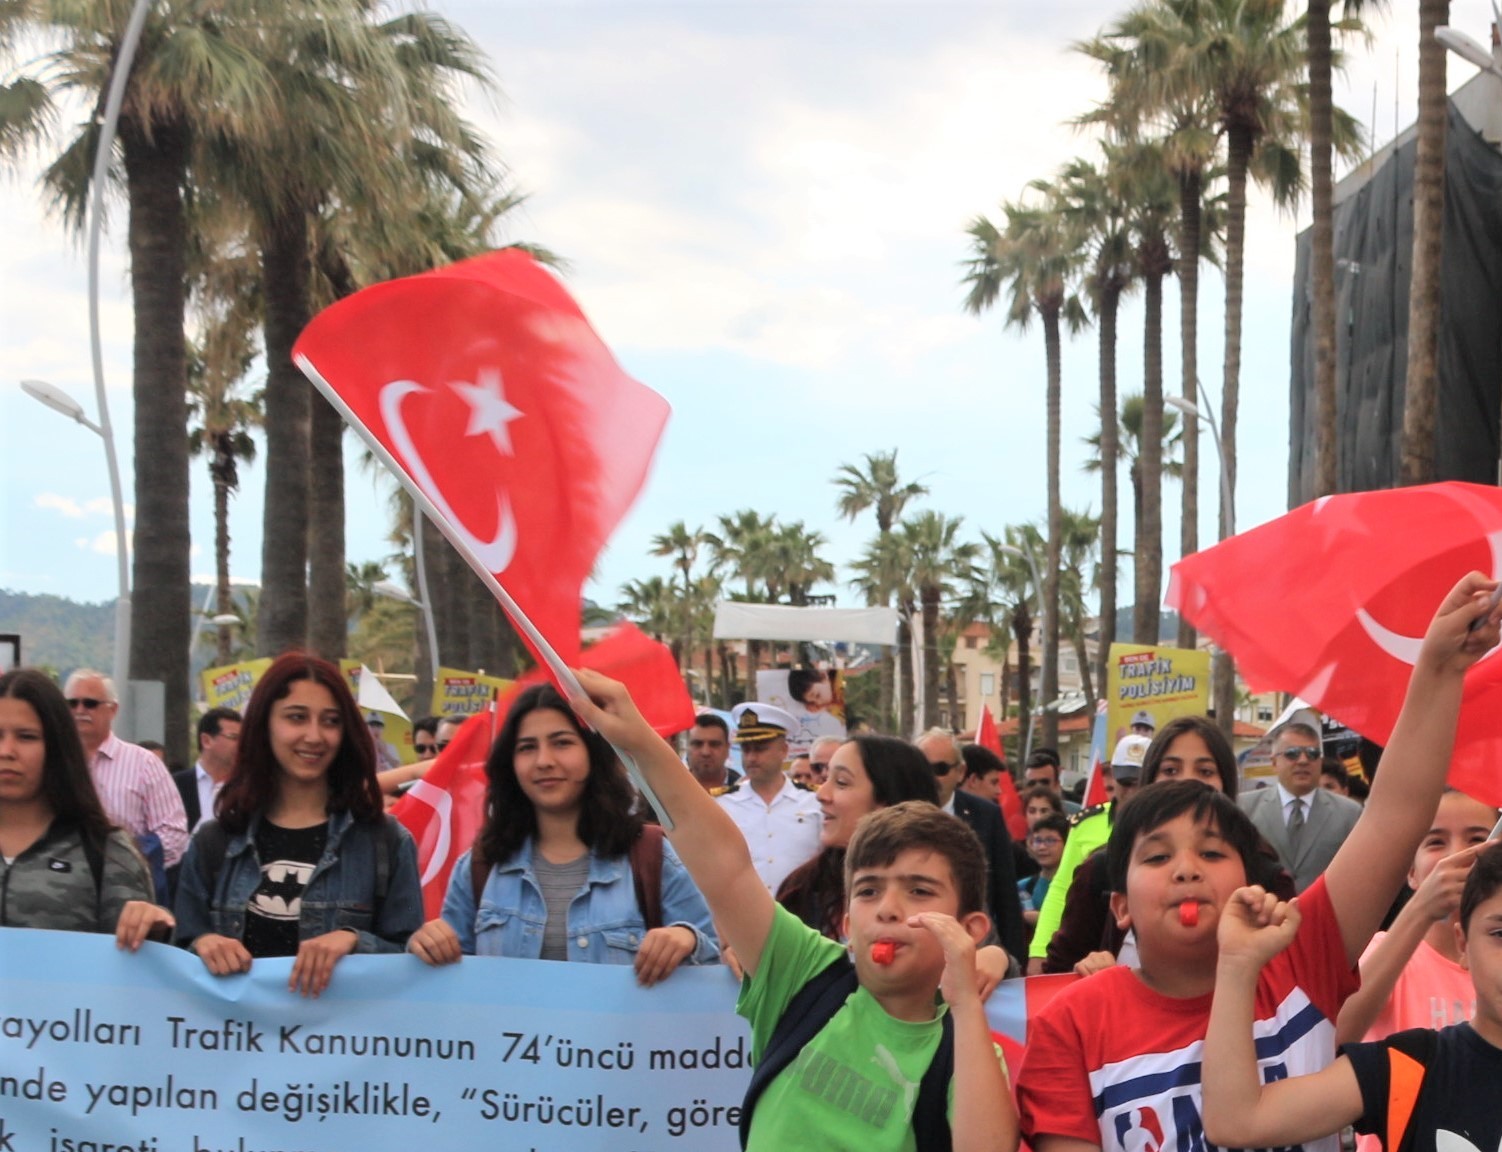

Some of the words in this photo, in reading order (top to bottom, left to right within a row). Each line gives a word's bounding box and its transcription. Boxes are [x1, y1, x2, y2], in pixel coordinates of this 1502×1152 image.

[0, 1008, 140, 1049] ayolları
[167, 1016, 264, 1052] Trafik
[279, 1024, 475, 1061] Kanununun
[86, 1074, 218, 1117] yapılan
[237, 1078, 441, 1124] değişiklikle,
